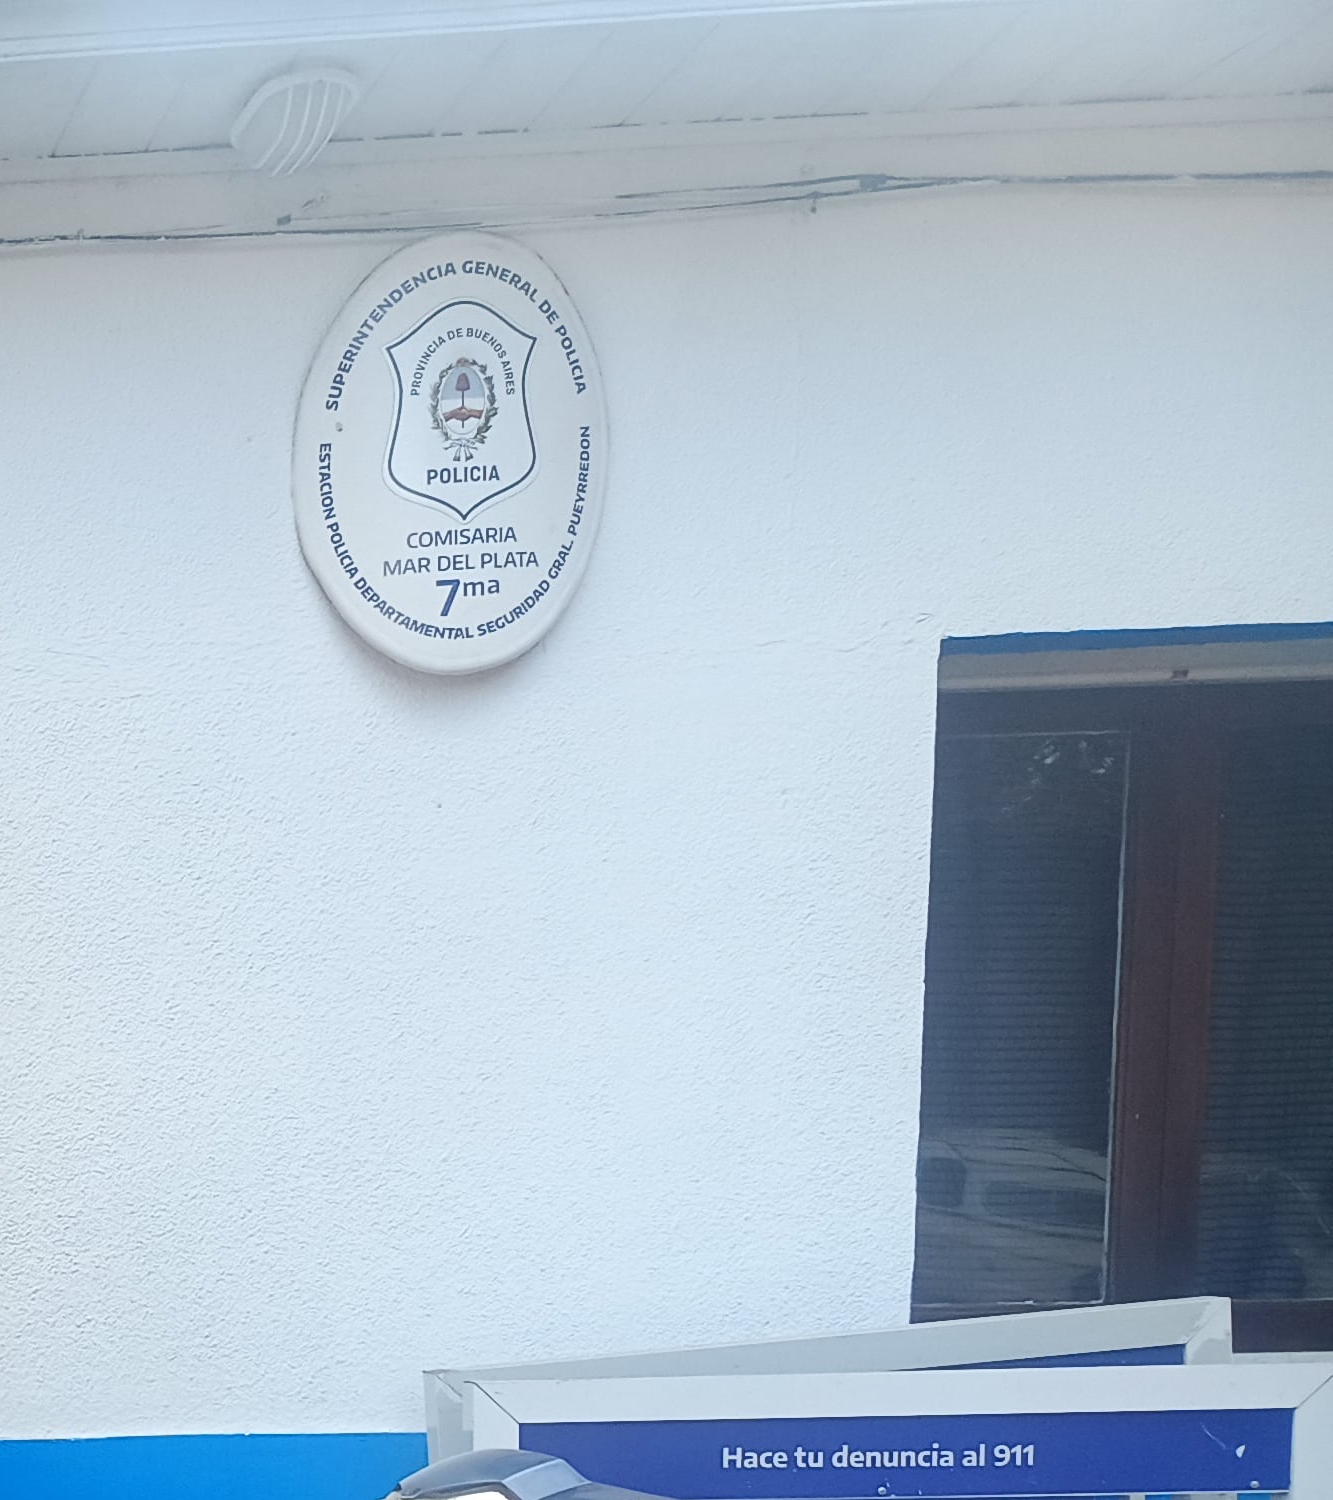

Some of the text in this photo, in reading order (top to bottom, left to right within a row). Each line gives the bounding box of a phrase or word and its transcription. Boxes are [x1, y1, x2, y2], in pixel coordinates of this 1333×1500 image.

[326, 260, 587, 411] SUPERINTENDENCIA GENERAL DE POLICIA
[410, 328, 515, 396] PROVINCIA DE BUENOS AIRES
[426, 464, 500, 486] POLICIA
[318, 426, 590, 640] ESTACION POLICIA DEPARTAMENTAL SEGURIDAD GRAL. PUEYRREDON
[406, 526, 518, 549] COMISARIA
[383, 551, 540, 577] MAR DEL PLATA
[722, 1442, 1034, 1469] Hace tu denuncia al 911
